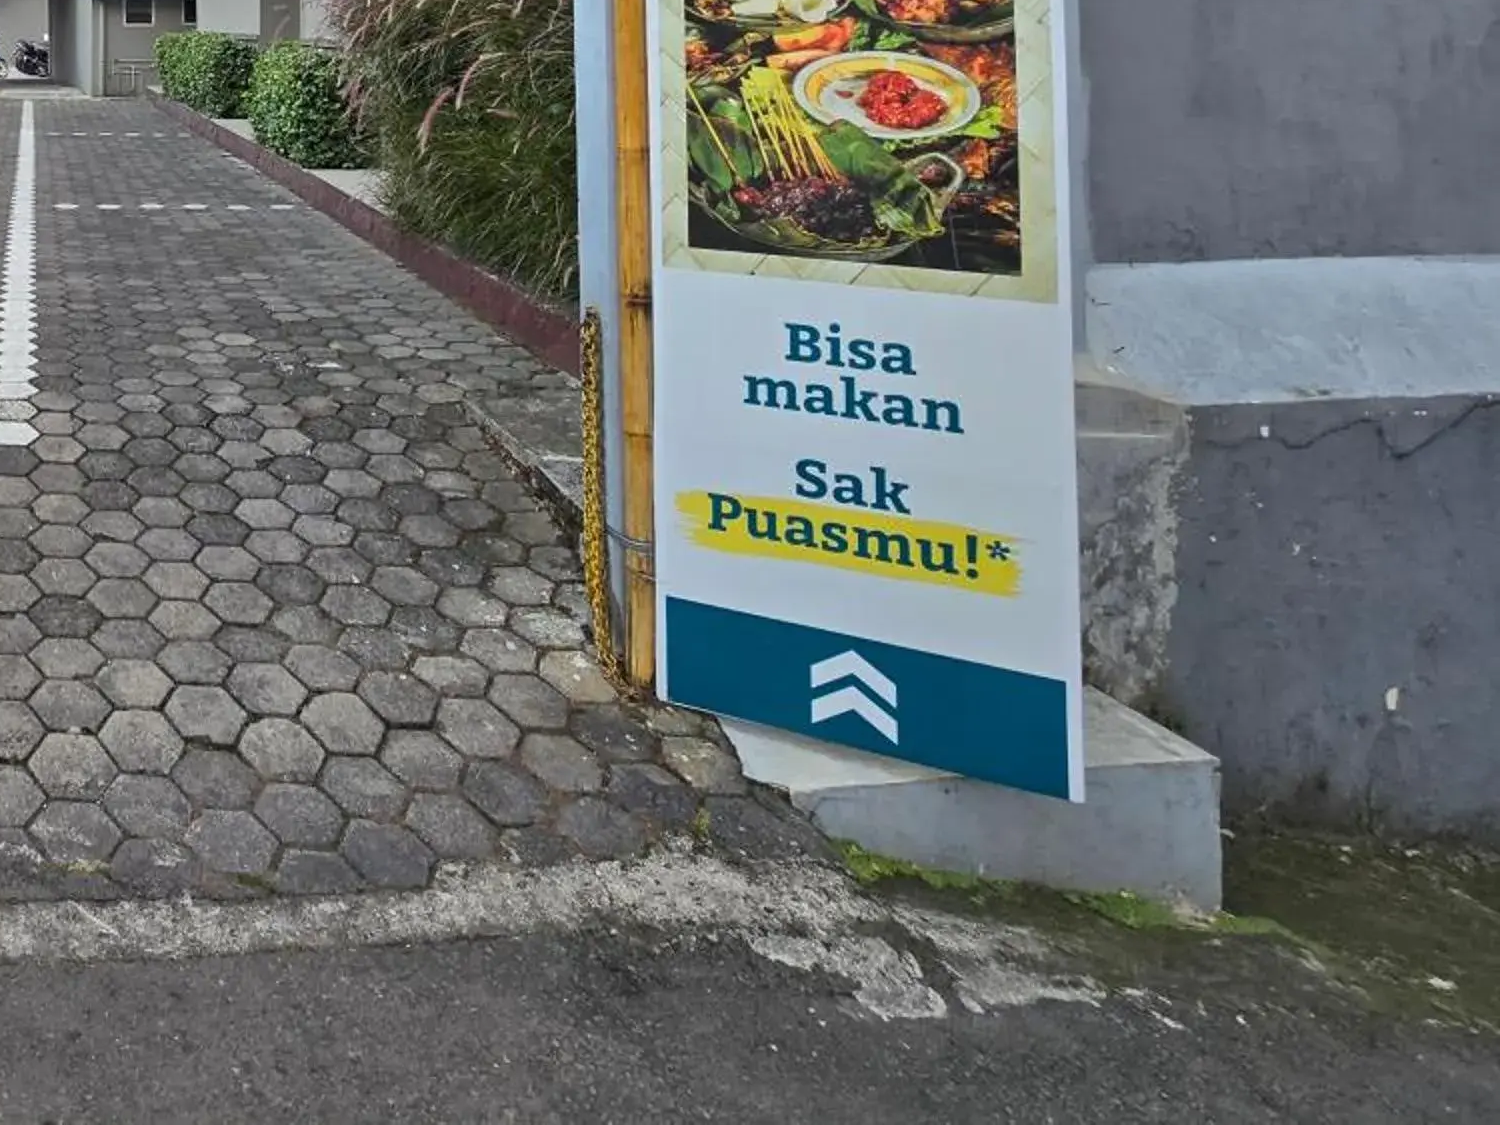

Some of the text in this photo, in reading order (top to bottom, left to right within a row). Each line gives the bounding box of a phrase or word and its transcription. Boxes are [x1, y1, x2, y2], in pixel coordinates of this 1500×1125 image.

[784, 322, 916, 375] Bisa
[743, 375, 965, 434] makan
[795, 458, 910, 515] Sak
